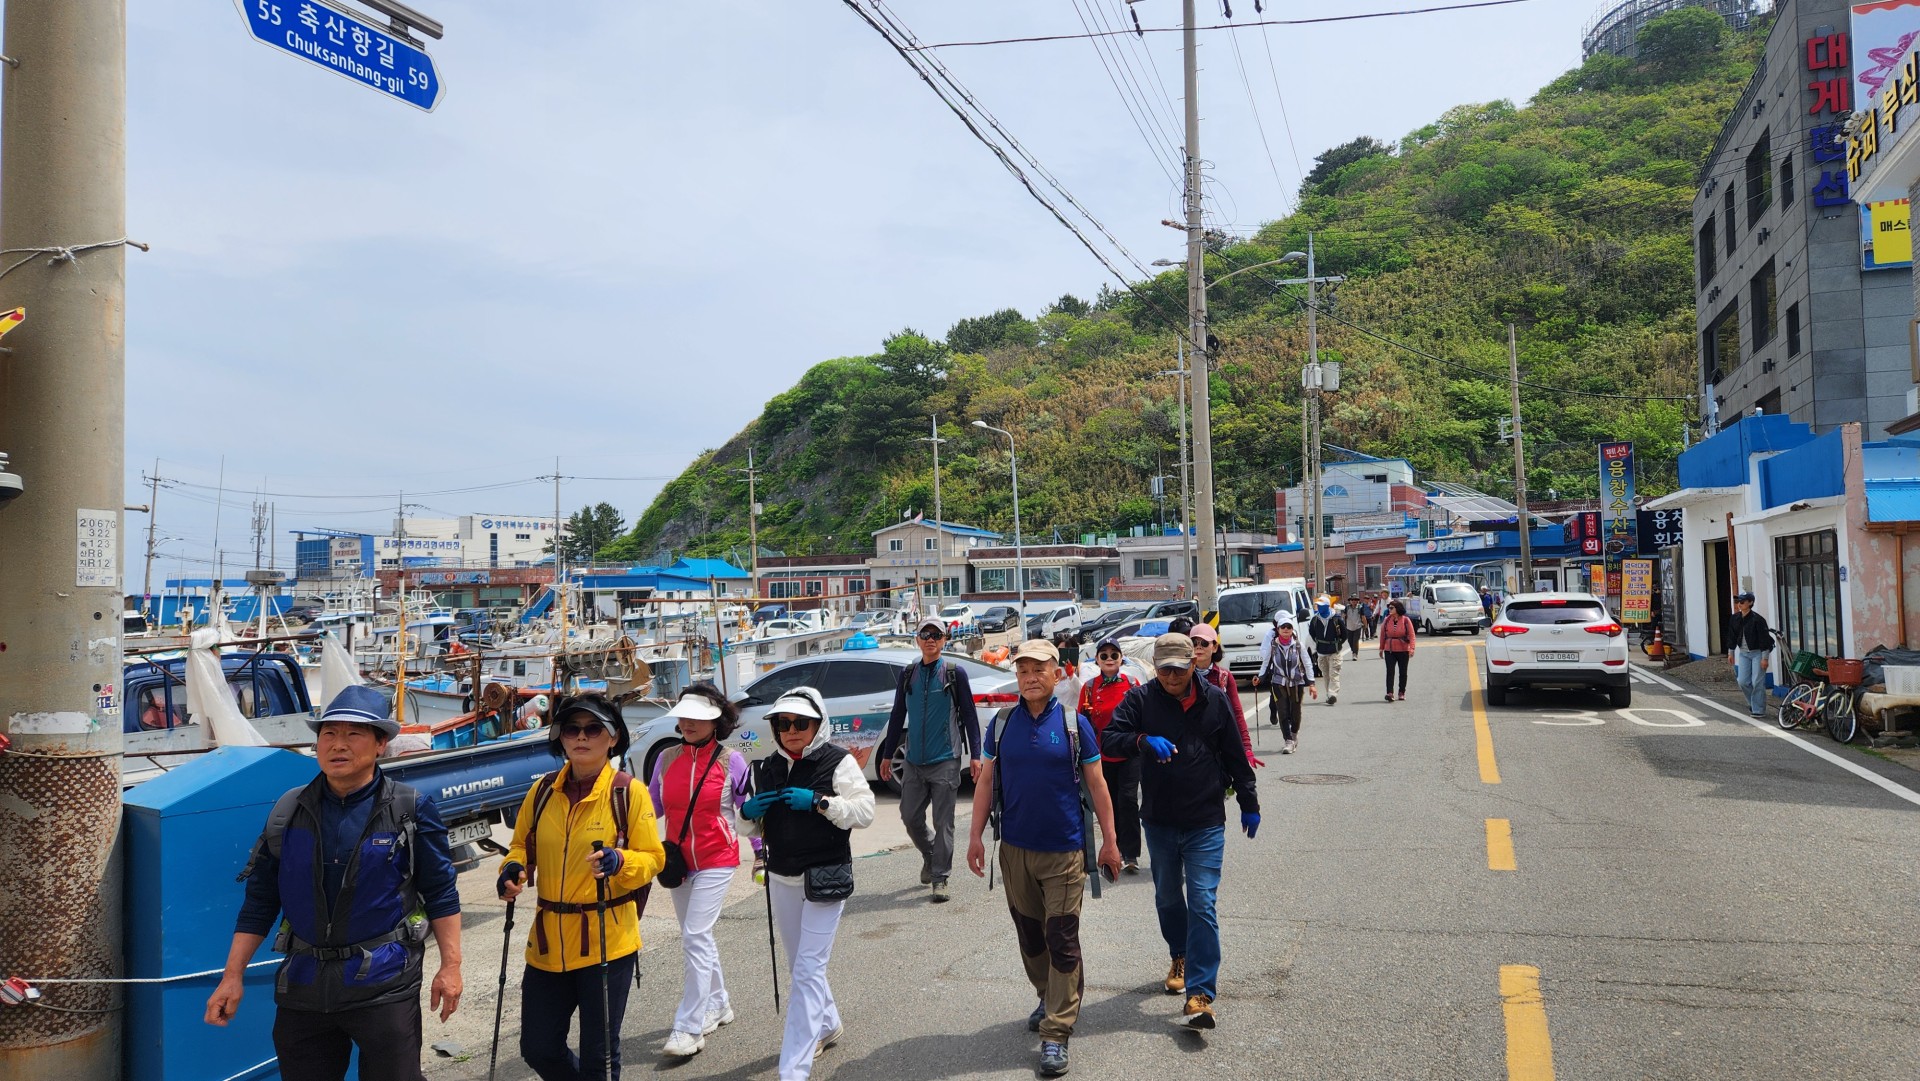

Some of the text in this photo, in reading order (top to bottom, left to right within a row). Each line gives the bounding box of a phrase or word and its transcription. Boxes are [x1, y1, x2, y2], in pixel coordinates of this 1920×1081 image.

[258, 1, 281, 26] 55
[298, 3, 394, 70] 축산항길
[286, 30, 405, 95] Chuksanhang-gil
[408, 66, 428, 90] 59
[1807, 32, 1849, 117] 대게
[1847, 51, 1918, 182] 슈퍼 부식
[1880, 219, 1911, 232] 매스
[1606, 446, 1627, 458] 펜션
[1607, 460, 1630, 535] 융창수산
[80, 519, 116, 529] 2067G
[89, 528, 110, 538] 322
[1586, 514, 1595, 536] 자연산
[1585, 540, 1598, 552] 회
[1624, 610, 1649, 620] 택배
[1625, 599, 1649, 609] 포장
[441, 776, 505, 799] HYUNDAI
[460, 822, 486, 840] 7213
